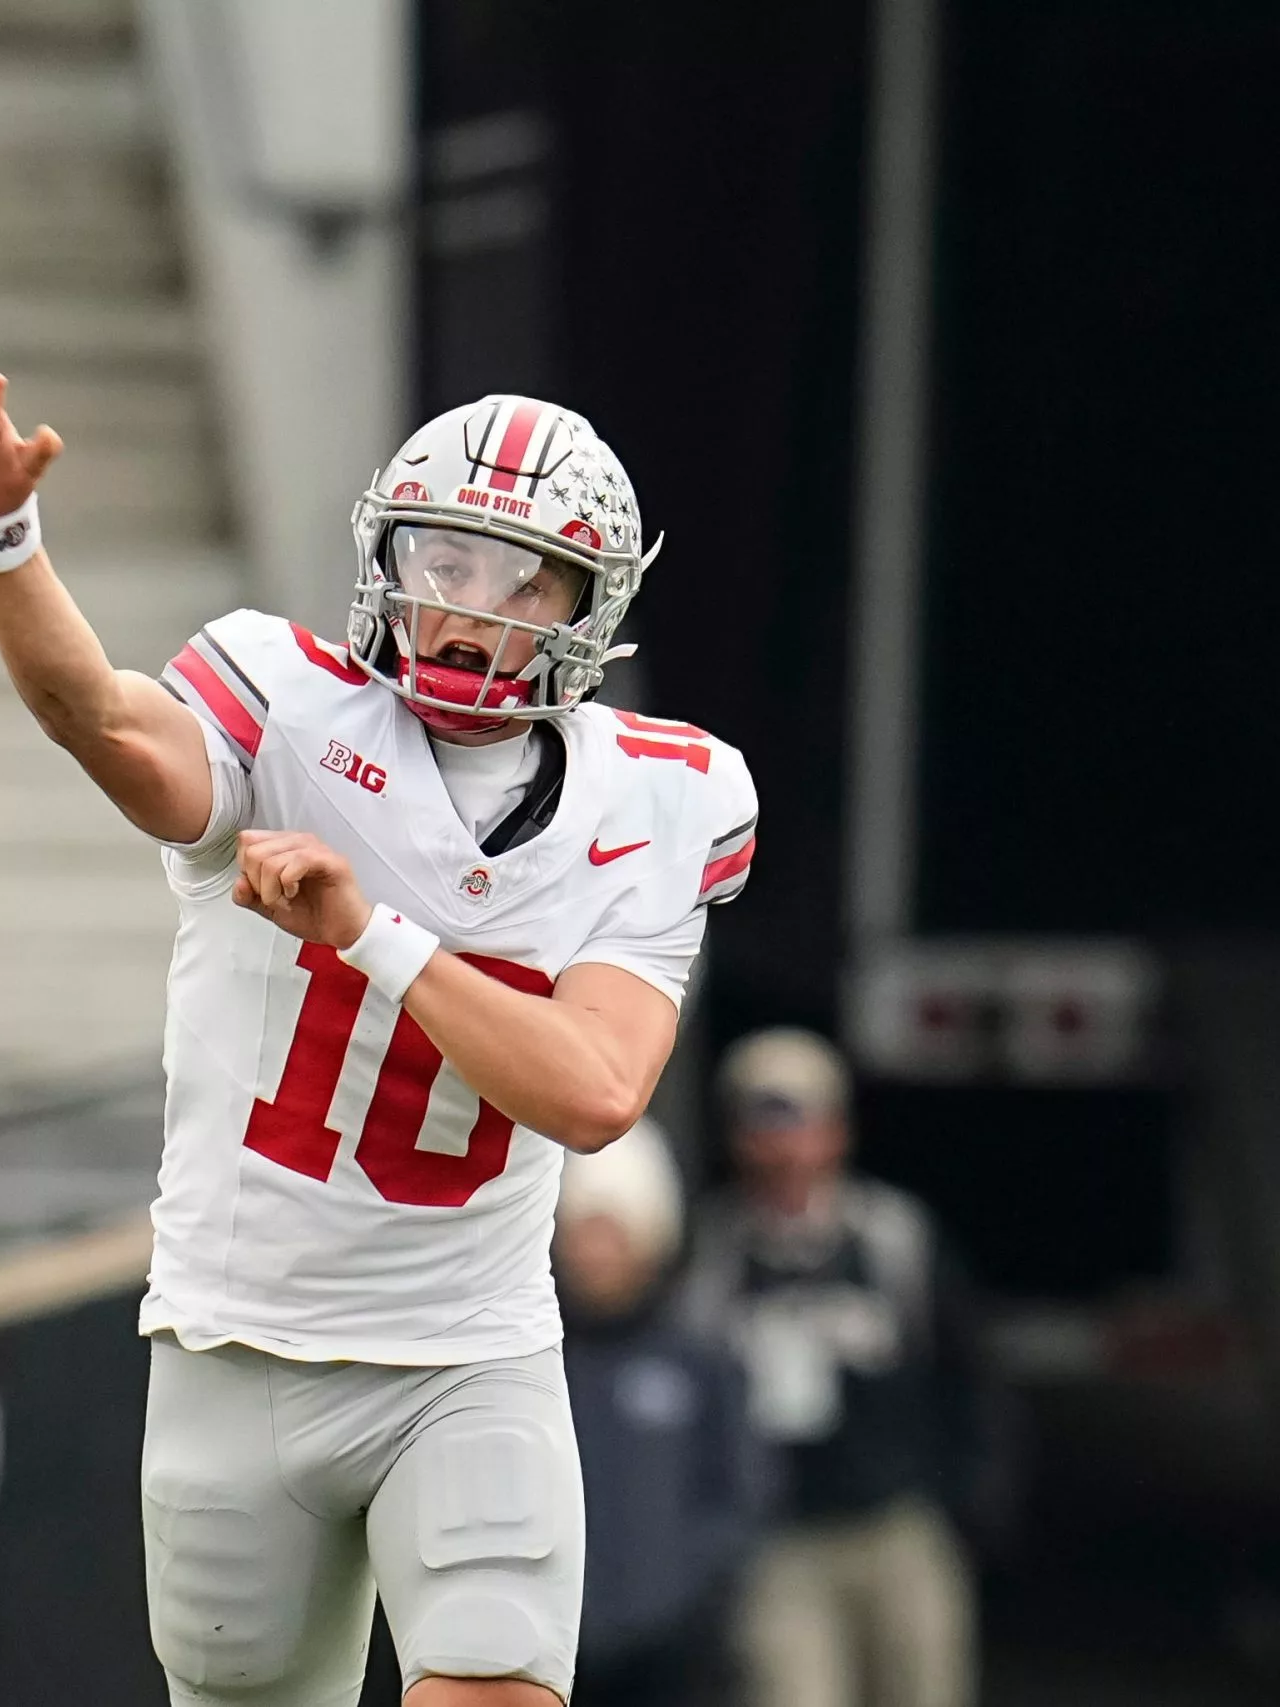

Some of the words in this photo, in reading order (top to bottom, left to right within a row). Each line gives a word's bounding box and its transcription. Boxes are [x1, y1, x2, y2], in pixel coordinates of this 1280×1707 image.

[458, 488, 489, 508] OHIO
[493, 495, 532, 519] STATE
[242, 940, 555, 1207] 10
